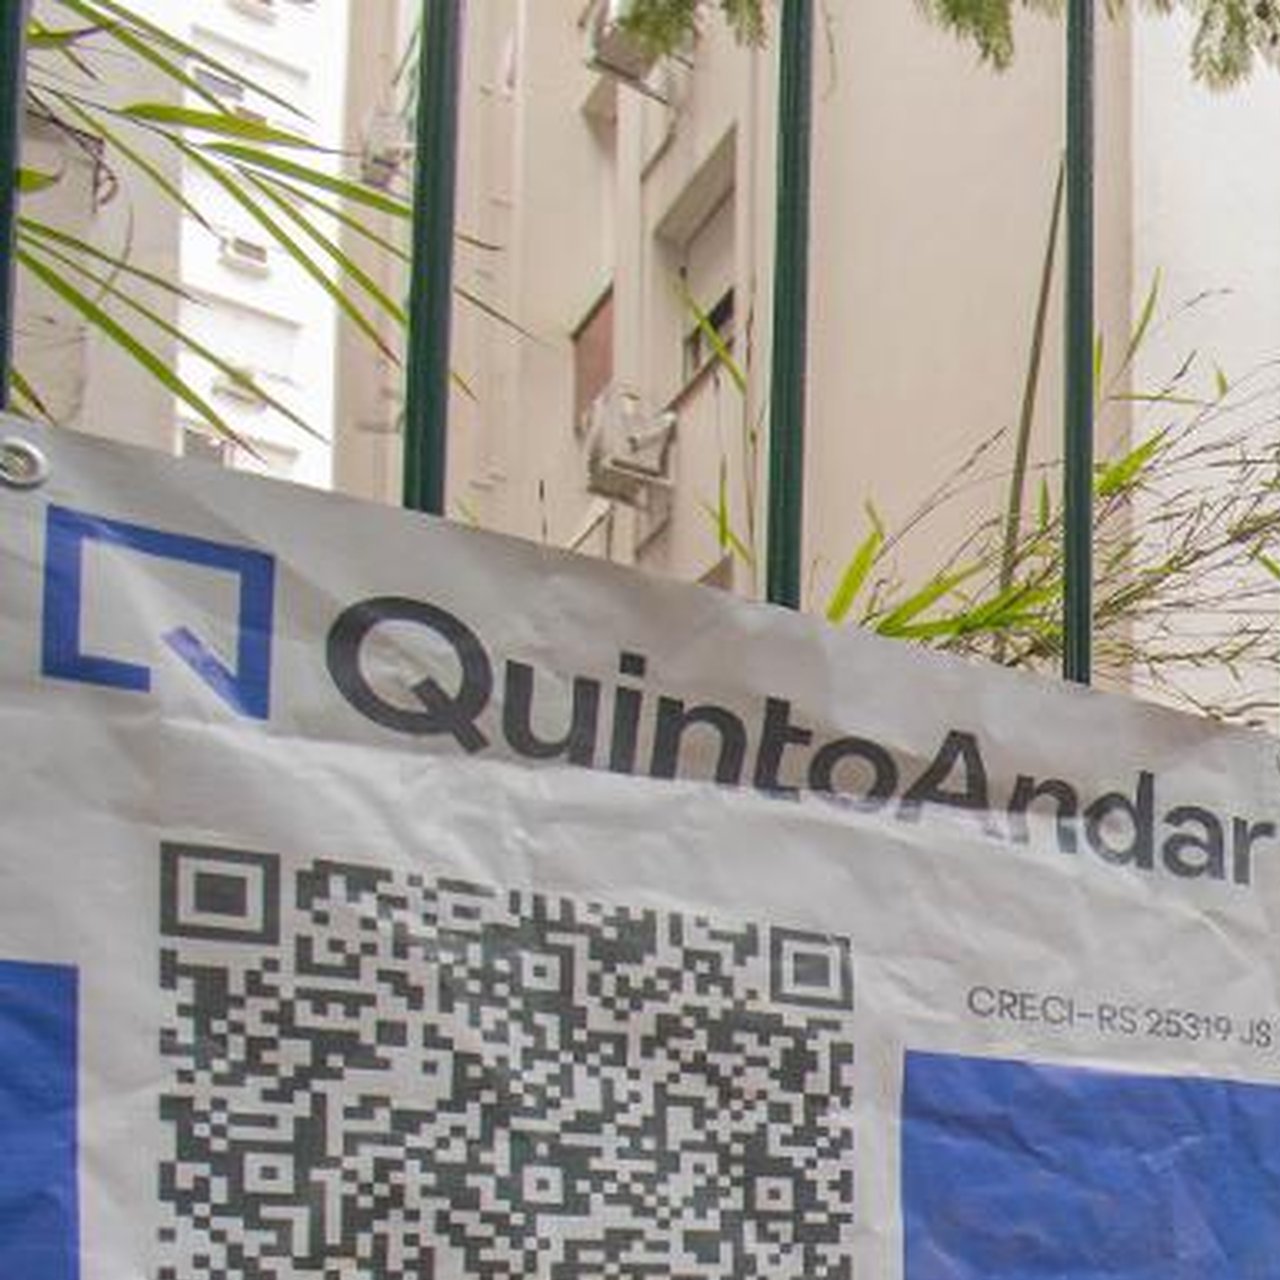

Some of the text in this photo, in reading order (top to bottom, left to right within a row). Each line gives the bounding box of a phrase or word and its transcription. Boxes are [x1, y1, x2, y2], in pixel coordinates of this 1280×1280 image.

[325, 594, 1278, 886] QuintoAndar
[966, 985, 1272, 1048] CRECI-RS 25319 JS
